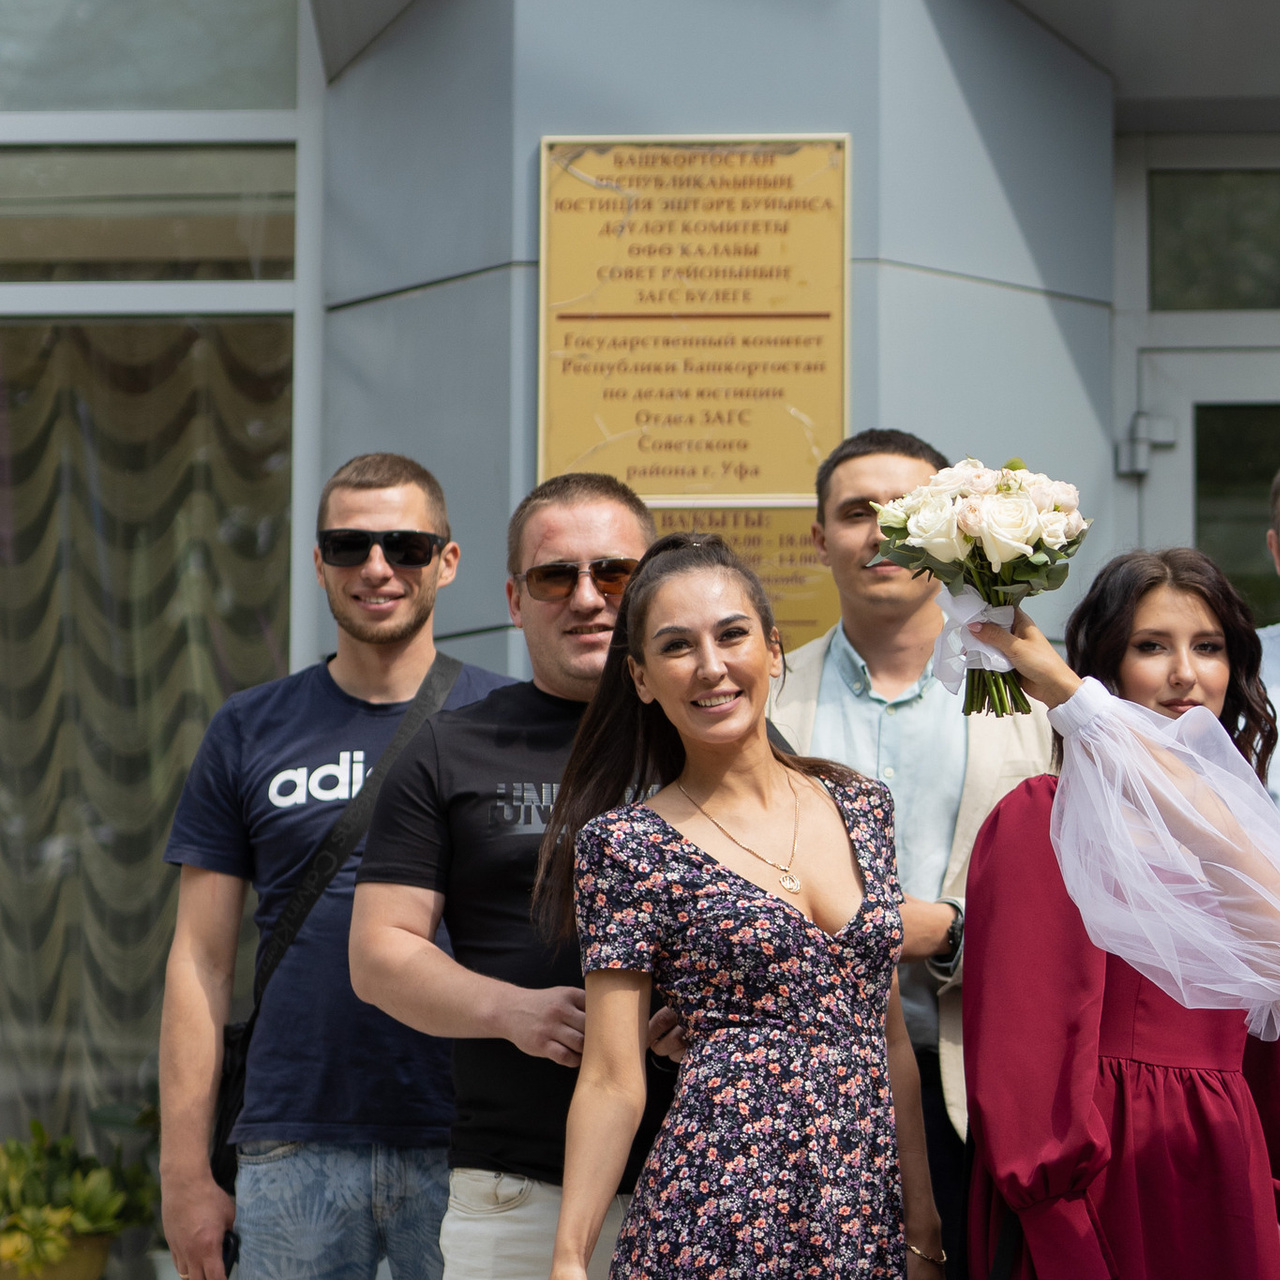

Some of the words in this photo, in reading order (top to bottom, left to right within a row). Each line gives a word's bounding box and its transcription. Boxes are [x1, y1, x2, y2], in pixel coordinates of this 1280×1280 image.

[596, 265, 656, 281] СОВЕТ
[636, 288, 680, 304] ЗАГС
[564, 331, 736, 353] Государственный
[741, 334, 825, 349] комитет
[561, 357, 677, 377] Республики
[682, 356, 827, 377] Башкортостан
[602, 387, 628, 401] по
[632, 386, 690, 403] делам
[696, 386, 785, 403] юстиции
[634, 409, 695, 428] Отдел
[702, 408, 752, 427] ЗАГС
[637, 434, 749, 453] Советского
[626, 461, 696, 481] района
[721, 459, 760, 482] Уфа
[268, 751, 373, 808] adi
